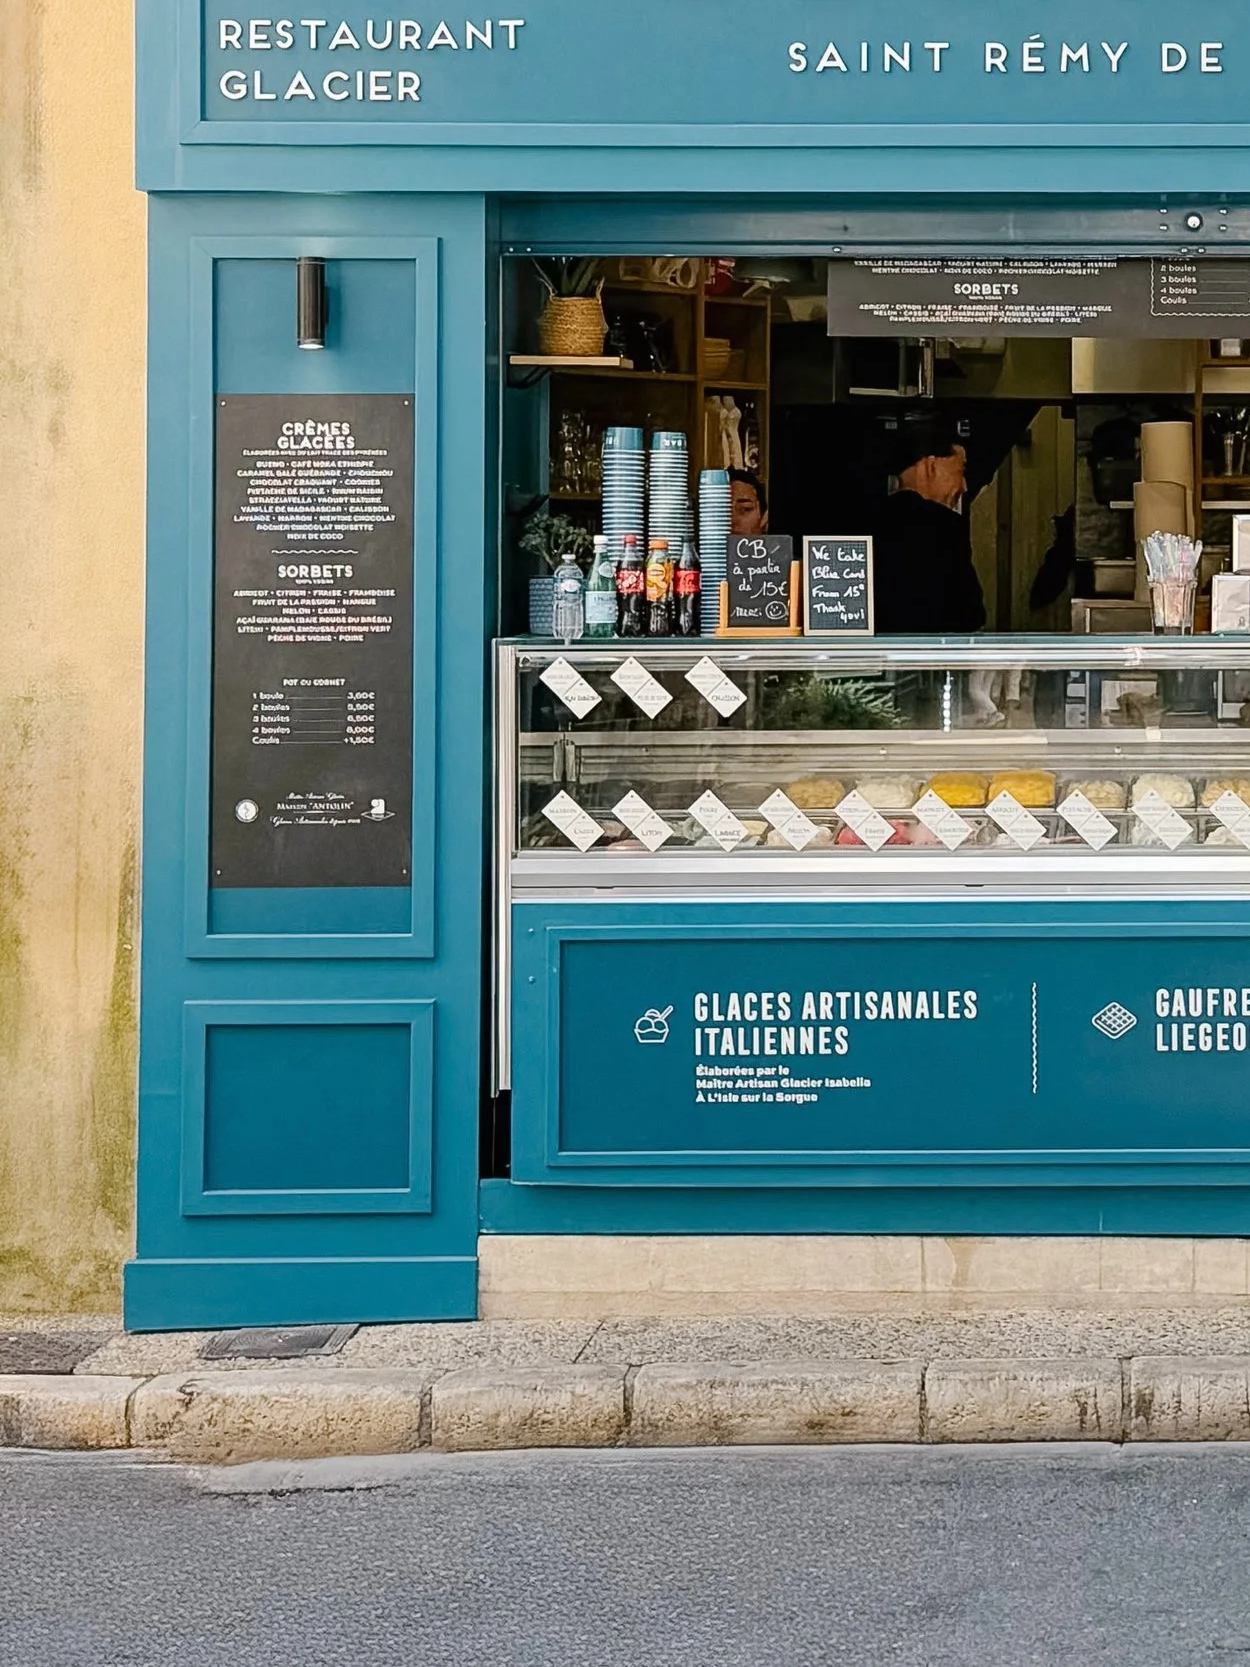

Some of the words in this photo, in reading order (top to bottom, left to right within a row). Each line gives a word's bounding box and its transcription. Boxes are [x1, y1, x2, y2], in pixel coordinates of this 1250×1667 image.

[218, 19, 526, 50] RESTAURANT
[787, 40, 952, 73] SAINT
[984, 33, 1132, 73] RÉMY
[1160, 40, 1224, 73] DE
[219, 70, 422, 101] GLACIER
[1169, 264, 1196, 272] boules
[953, 283, 1019, 295] SORBETS
[281, 419, 351, 436] CRÈMES
[277, 434, 355, 450] GLACÉES
[291, 460, 311, 468] CAFÉ
[736, 538, 767, 559] CB
[812, 545, 830, 560] We
[838, 548, 865, 561] take
[278, 565, 353, 578] SORBETS
[733, 563, 743, 575] à
[747, 558, 780, 581] partir
[843, 568, 865, 578] Card
[813, 602, 846, 613] Thank
[694, 992, 792, 1022] GLACES
[801, 989, 979, 1021] ARTISANALES
[694, 1025, 850, 1056] ITALIENNES
[756, 1066, 777, 1079] par
[779, 1066, 790, 1077] le
[735, 1077, 779, 1089] Artisan
[780, 1077, 823, 1089] Glacier
[740, 1093, 760, 1103] sur
[761, 1091, 775, 1103] la
[776, 1091, 819, 1106] Sorgue
